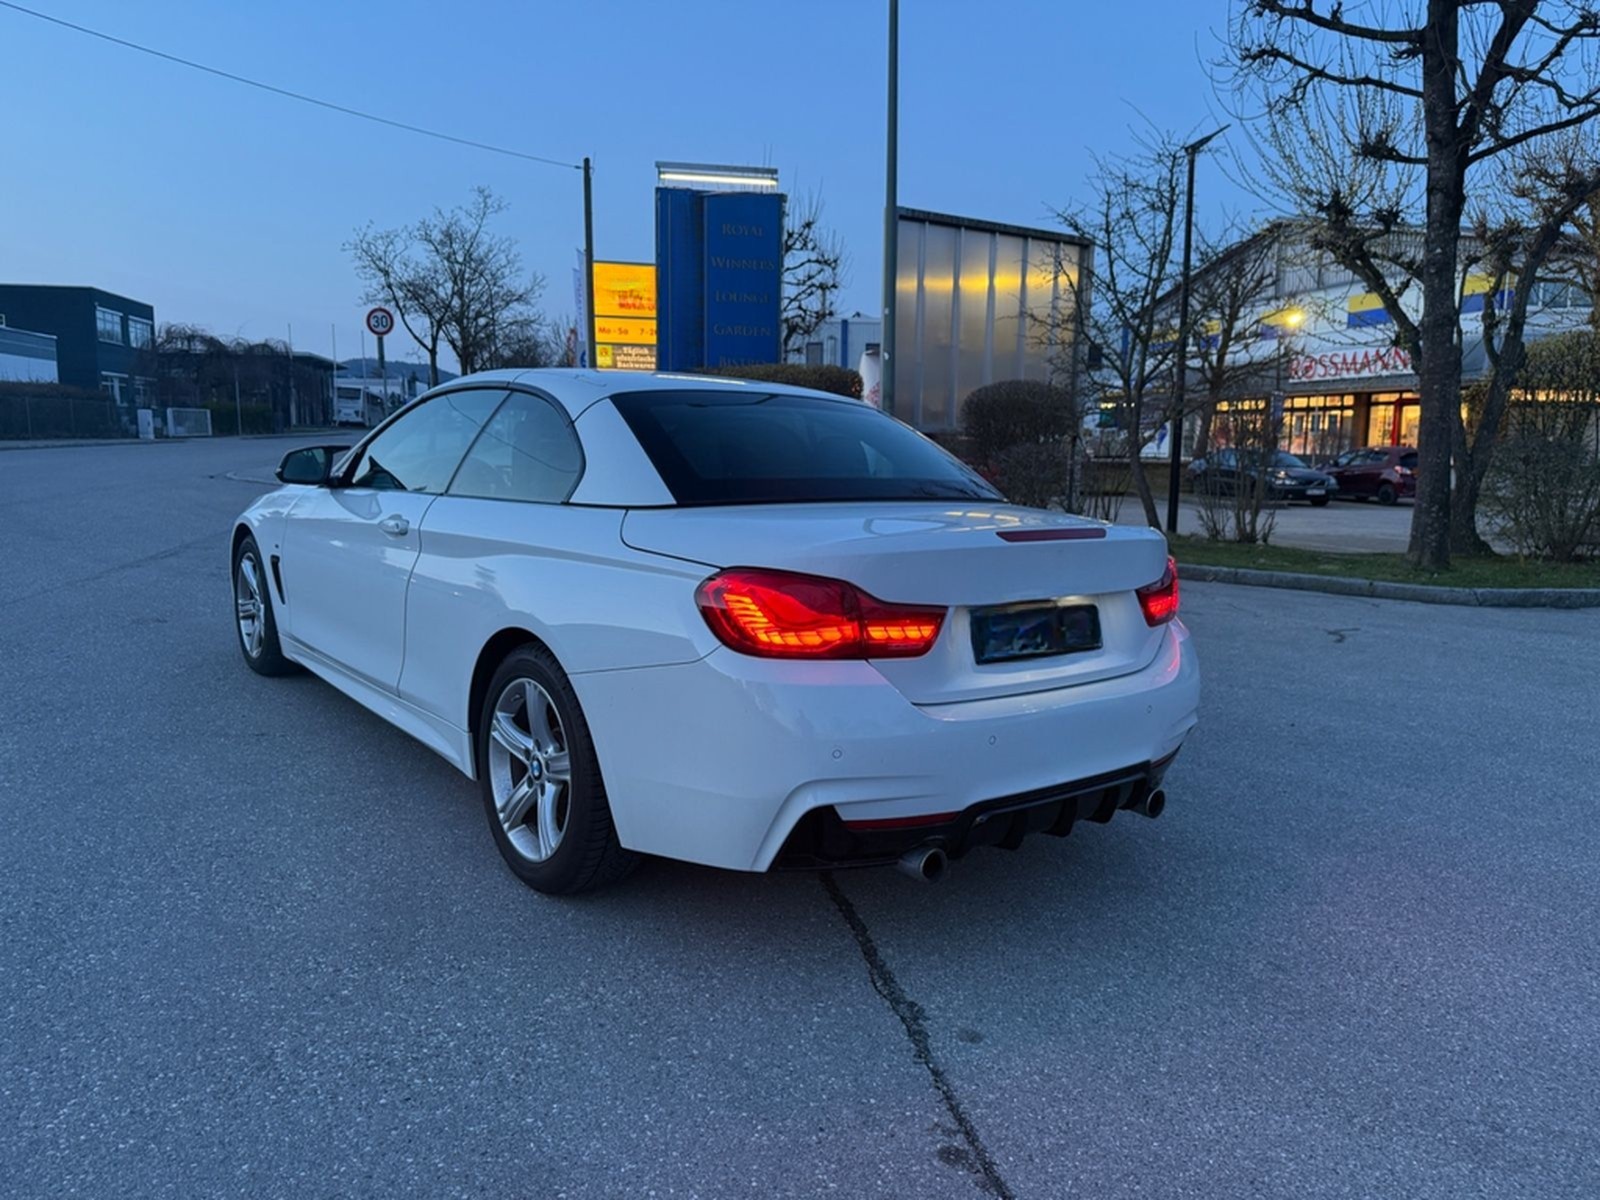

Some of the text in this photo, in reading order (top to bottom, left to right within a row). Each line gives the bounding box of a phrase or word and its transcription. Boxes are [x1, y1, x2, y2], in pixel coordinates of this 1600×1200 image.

[722, 223, 764, 237] ROYAL
[711, 256, 775, 271] WINNERS
[714, 290, 769, 304] LOUNGE
[372, 314, 388, 328] 30
[598, 327, 611, 335] Mo
[713, 323, 771, 337] GARDEN
[1290, 347, 1410, 379] ROSSMANN
